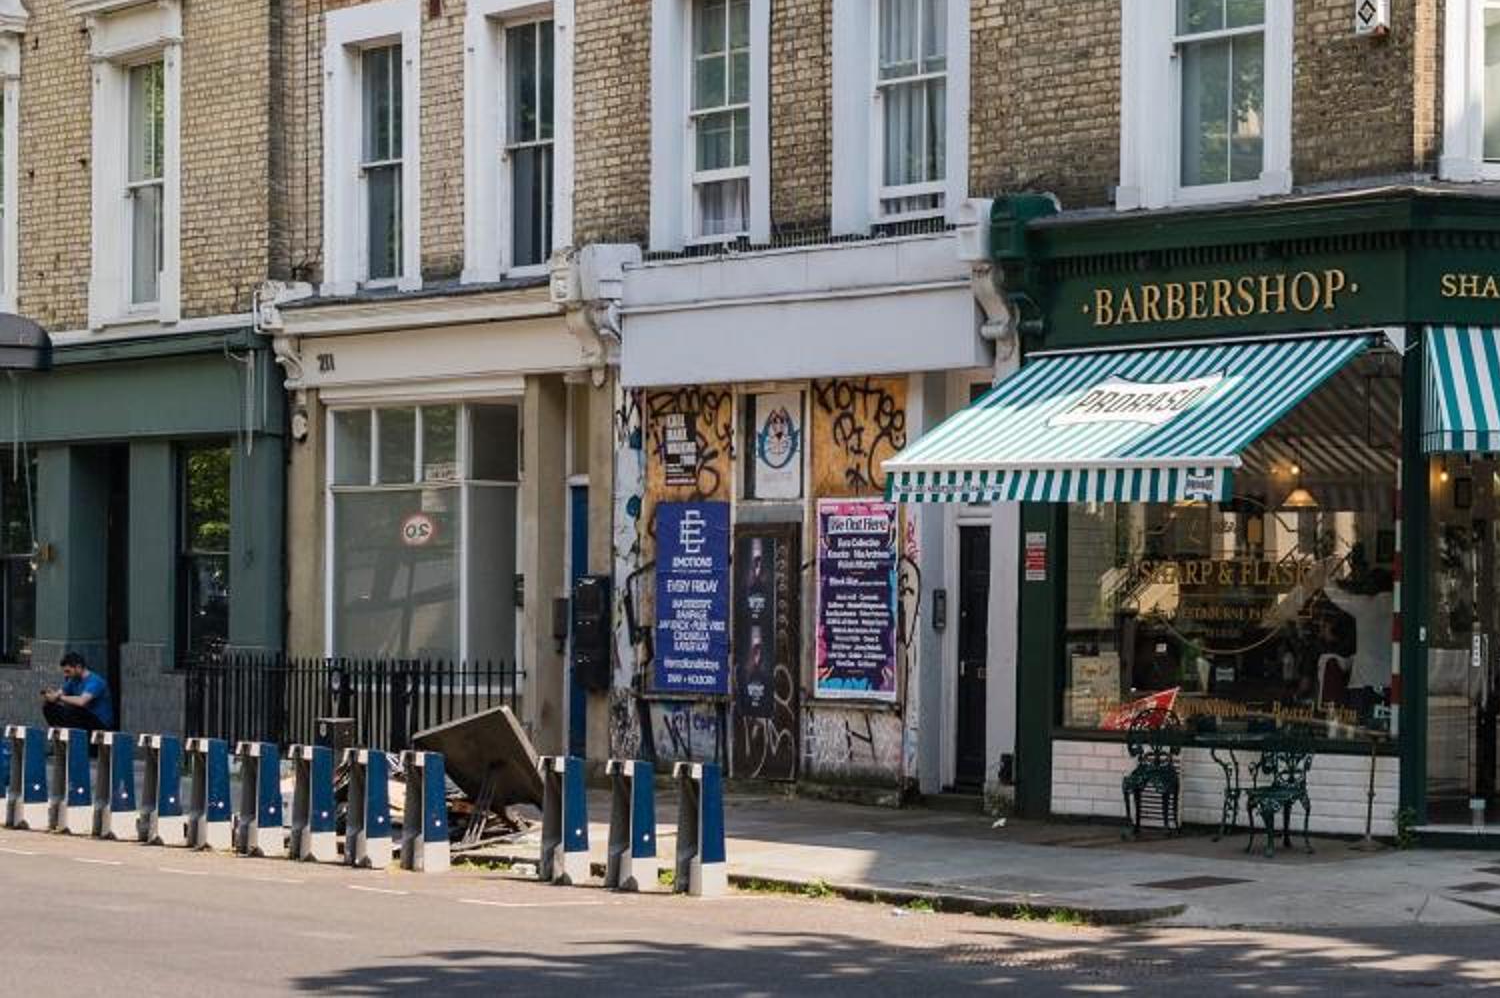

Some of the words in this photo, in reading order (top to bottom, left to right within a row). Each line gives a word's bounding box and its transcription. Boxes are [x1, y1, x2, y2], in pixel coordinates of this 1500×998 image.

[1094, 269, 1346, 326] BARBERSHOP
[1066, 385, 1207, 414] PRORASO
[1218, 561, 1233, 585] &
[692, 580, 719, 593] FRIDAY
